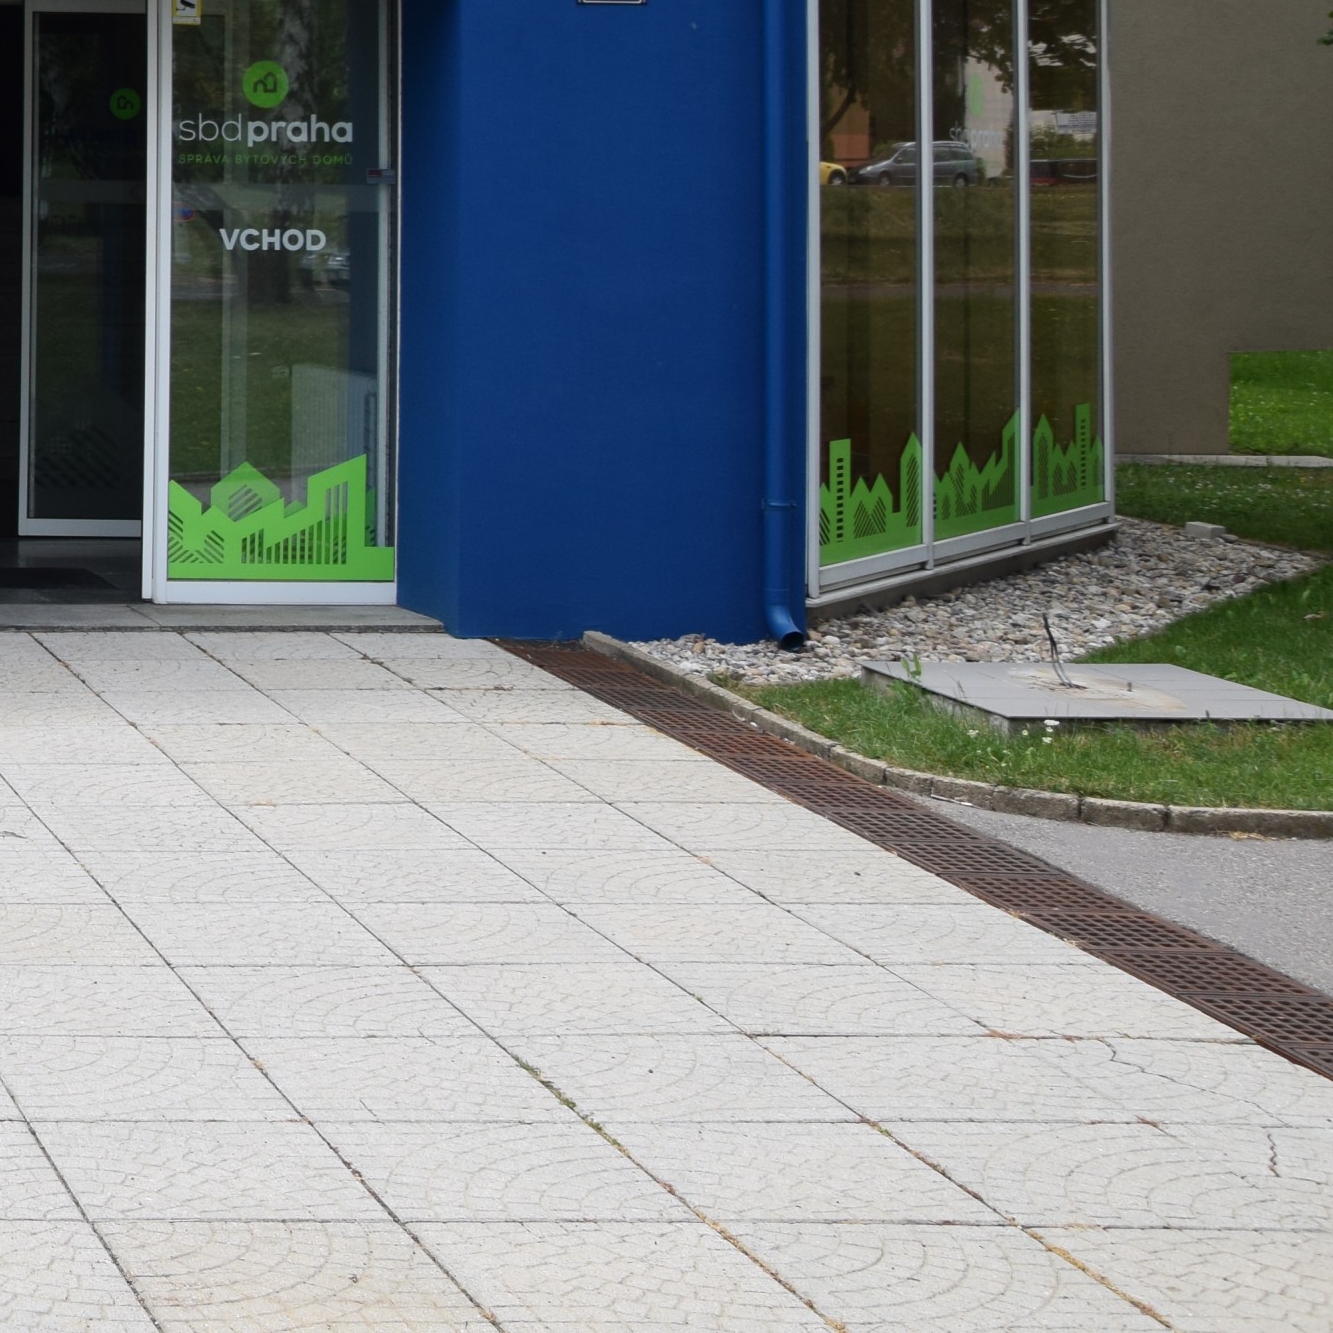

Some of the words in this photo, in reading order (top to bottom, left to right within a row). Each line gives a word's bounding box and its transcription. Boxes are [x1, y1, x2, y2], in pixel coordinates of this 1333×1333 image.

[179, 113, 353, 147] sbdpraha
[179, 153, 229, 163] SPRÁVA
[235, 153, 306, 164] BYTOVÝCH
[313, 153, 352, 165] DOMŮ
[219, 229, 326, 251] VCHOD
